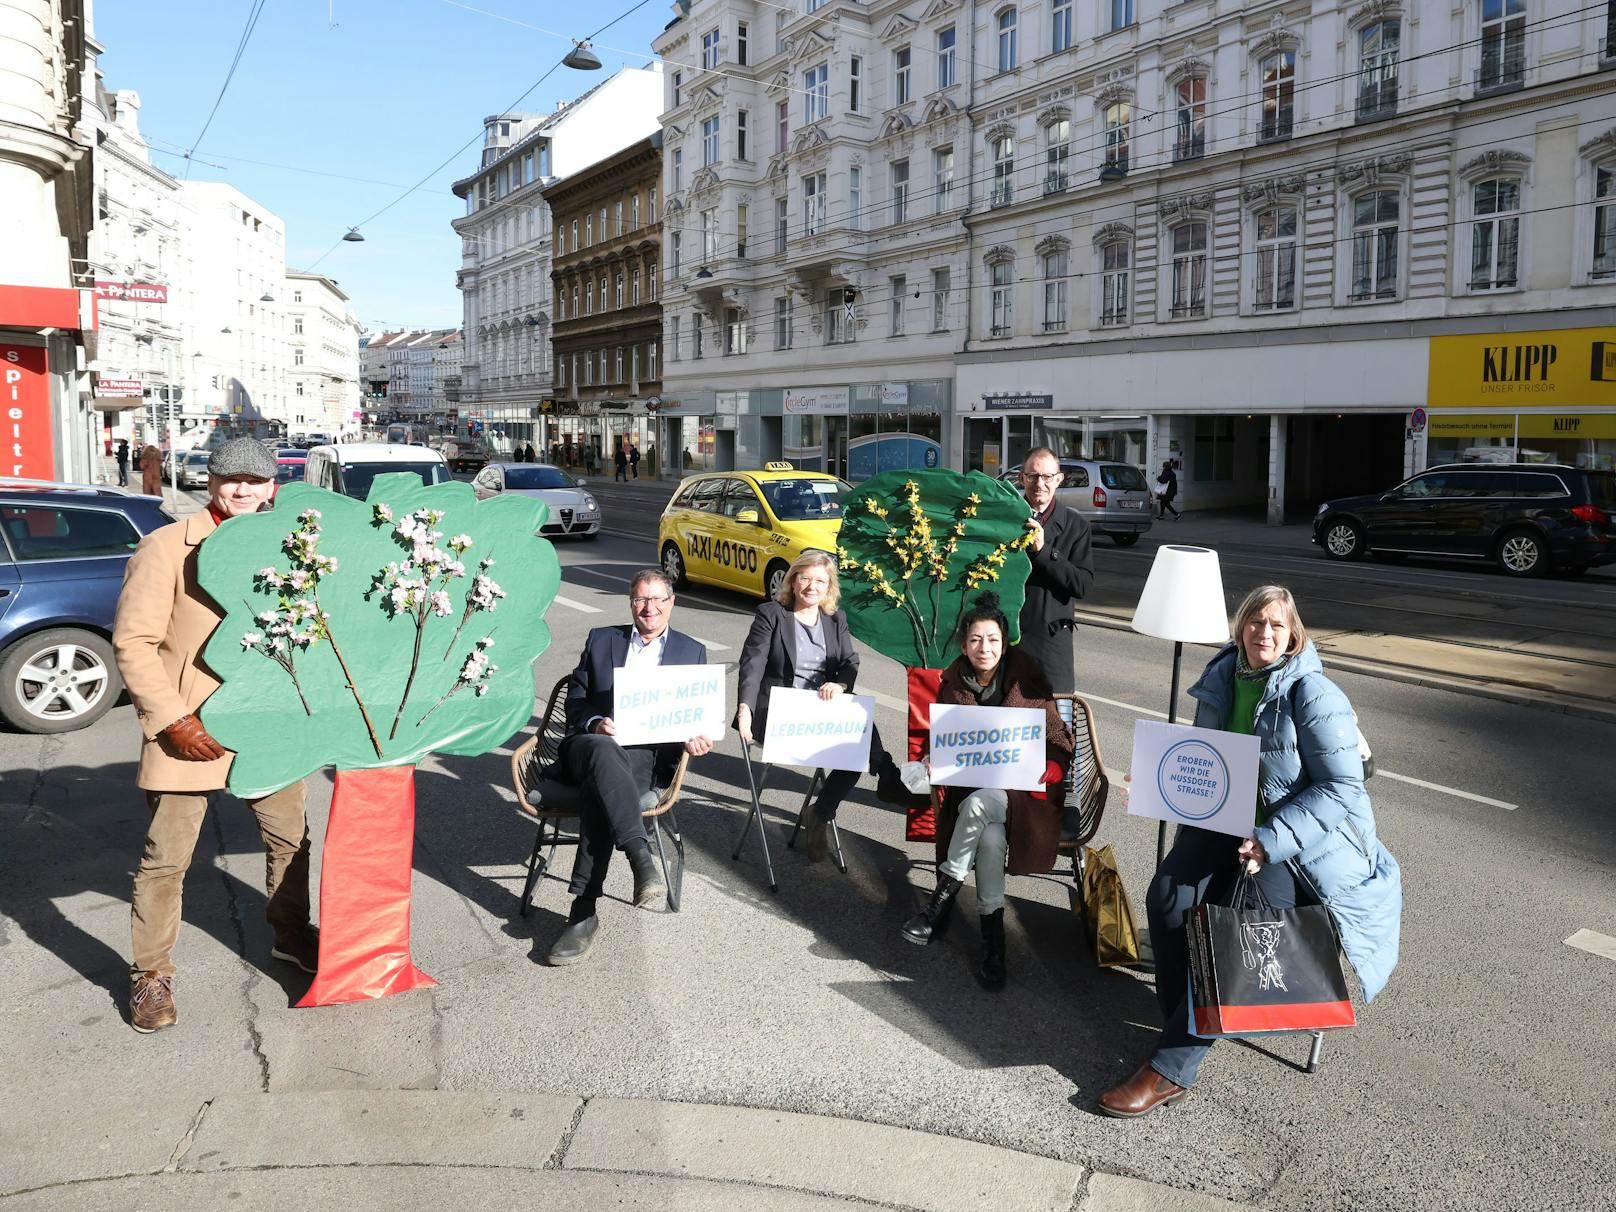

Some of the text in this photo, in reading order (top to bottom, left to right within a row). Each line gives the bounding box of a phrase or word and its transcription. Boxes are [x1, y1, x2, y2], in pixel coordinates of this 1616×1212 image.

[1482, 344, 1557, 382] KLIPP
[1480, 382, 1556, 394] UNSER FRISÖR
[1554, 418, 1580, 431] KLIPP
[685, 532, 757, 573] TAXI 40100
[620, 688, 660, 709] DEIN
[676, 680, 718, 700] MEIN
[770, 721, 867, 736] LEBENSRAUM
[935, 725, 1041, 748] NUSSDORFER
[956, 748, 1021, 767] STRASSE
[1177, 755, 1214, 768] EROBERN
[1180, 766, 1211, 777] WIR DIE
[1170, 774, 1217, 789] NUSSDOFER
